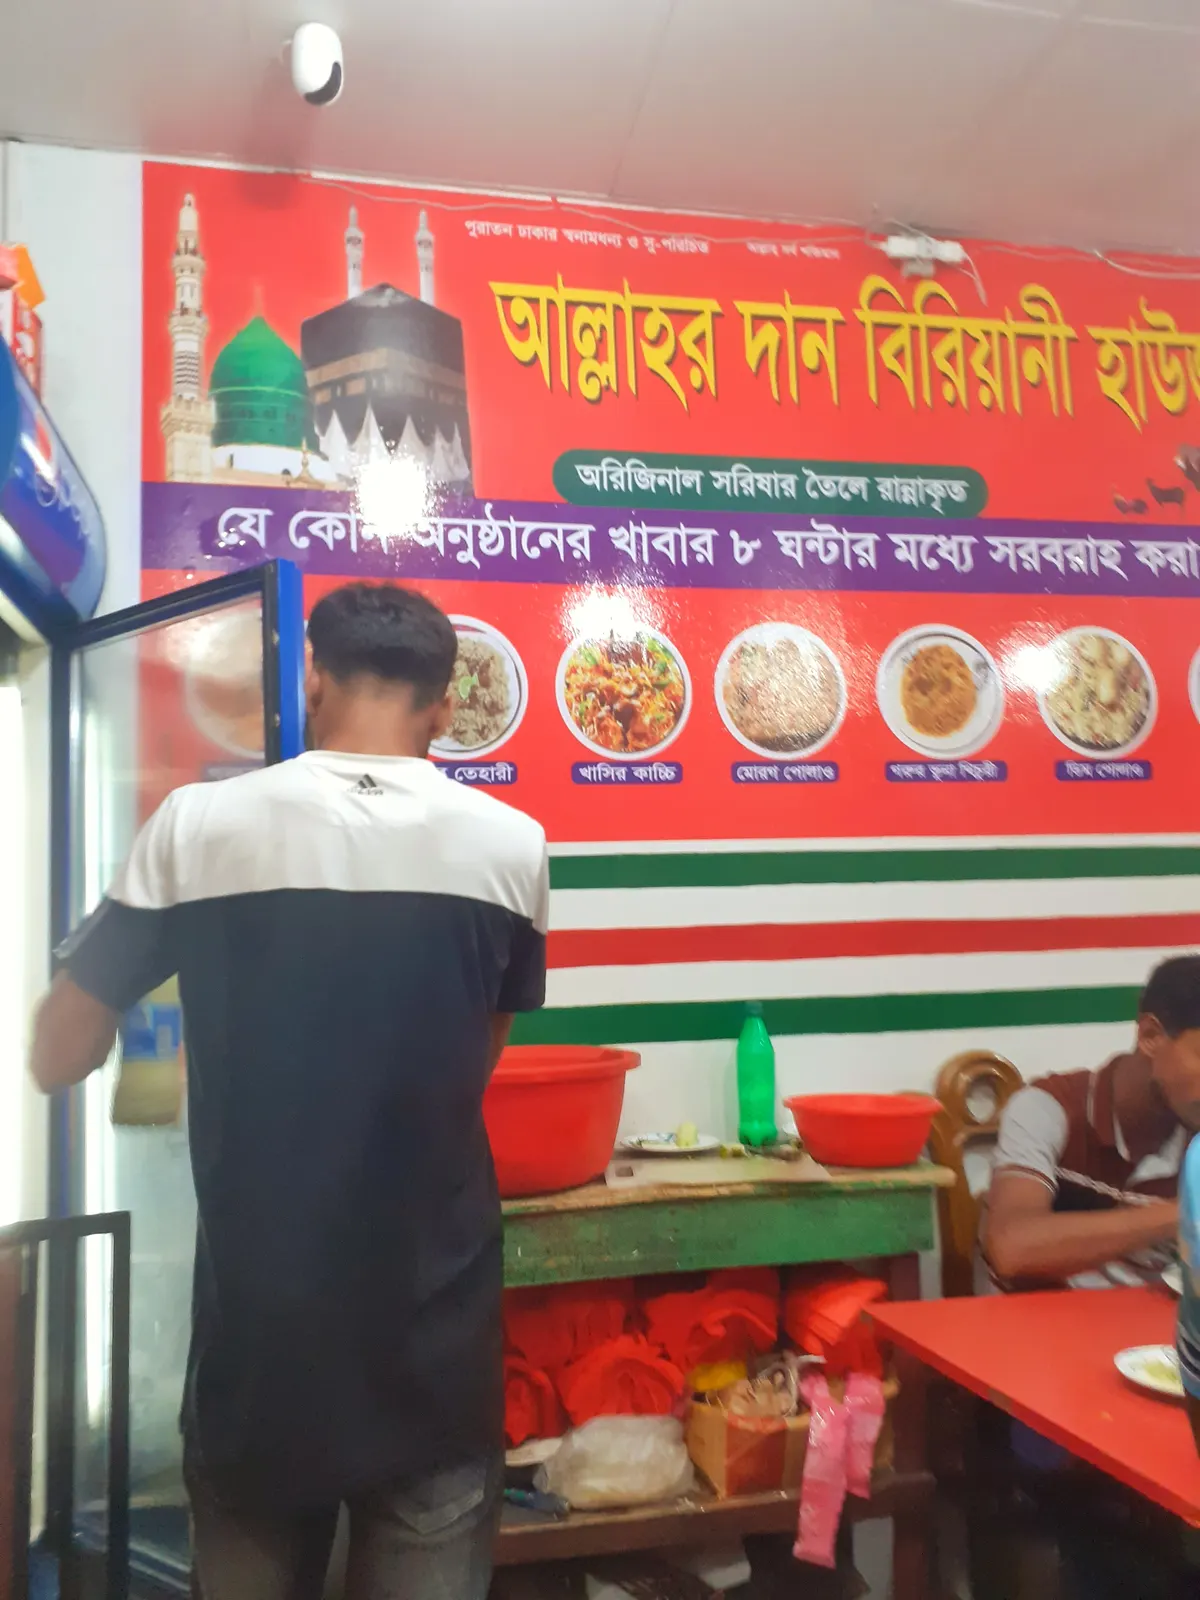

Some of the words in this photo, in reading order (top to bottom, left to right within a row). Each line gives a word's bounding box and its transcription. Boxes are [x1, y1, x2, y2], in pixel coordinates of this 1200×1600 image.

[465, 220, 514, 239] পুরাতন
[517, 224, 558, 242] ঢাকার
[627, 235, 639, 249] ও
[488, 272, 725, 413] আল্লাহর
[734, 289, 846, 407] দান
[852, 274, 1079, 420] বিরিয়ানী
[574, 456, 704, 497] অরিজিনাল
[708, 462, 799, 500] সরিষার
[801, 466, 871, 502] তৈলে
[873, 474, 970, 516] রান্নাকৃত
[217, 506, 274, 549] যে
[404, 502, 597, 570] অনুষ্ঠানের
[608, 519, 720, 567] খাবার
[729, 528, 762, 566] ৮
[771, 517, 881, 571] ঘন্টার
[885, 532, 980, 574] মধ্যে
[983, 533, 1127, 582] সরবরাহ
[454, 761, 514, 783] তেহারী
[579, 762, 628, 782] খাসির
[630, 762, 677, 782] কাচ্চি
